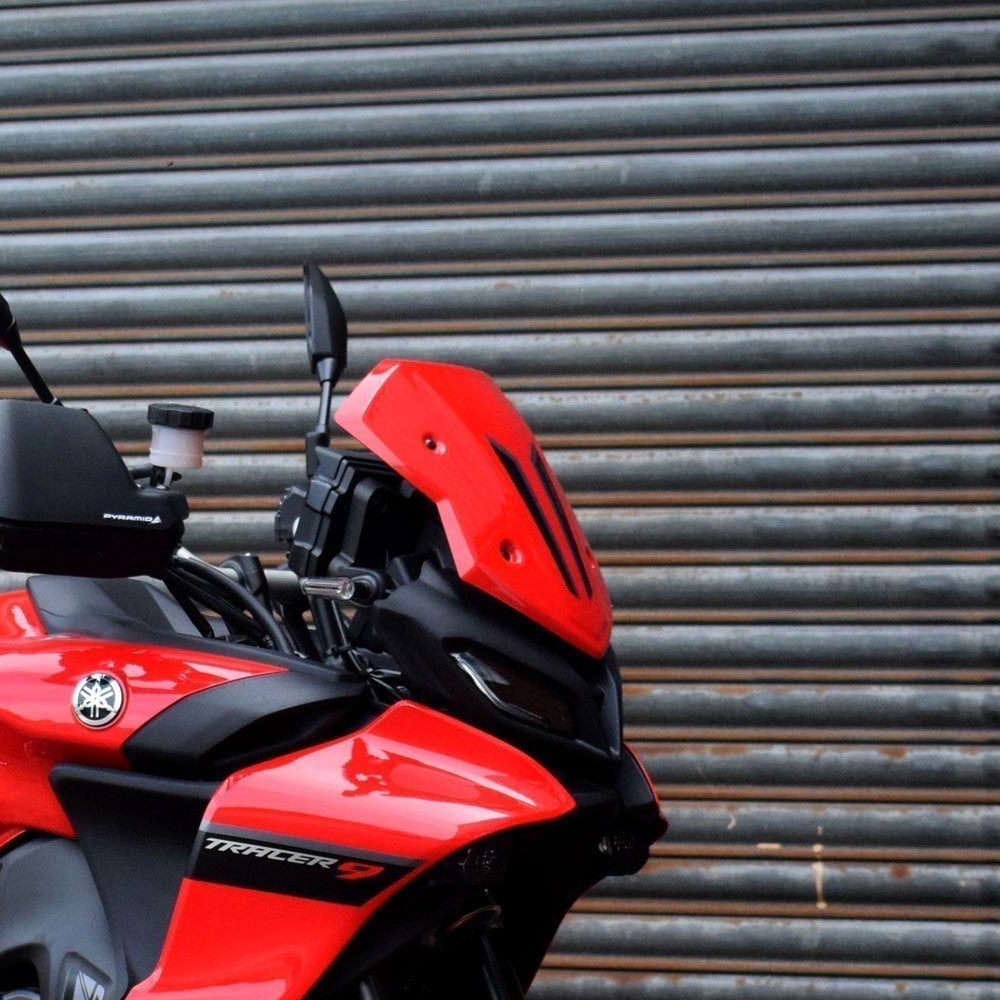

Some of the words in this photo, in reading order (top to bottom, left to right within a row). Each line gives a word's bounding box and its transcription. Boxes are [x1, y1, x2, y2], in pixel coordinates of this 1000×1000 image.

[103, 513, 153, 523] PYRAMID
[203, 837, 340, 869] TRACER
[334, 860, 385, 881] 9
